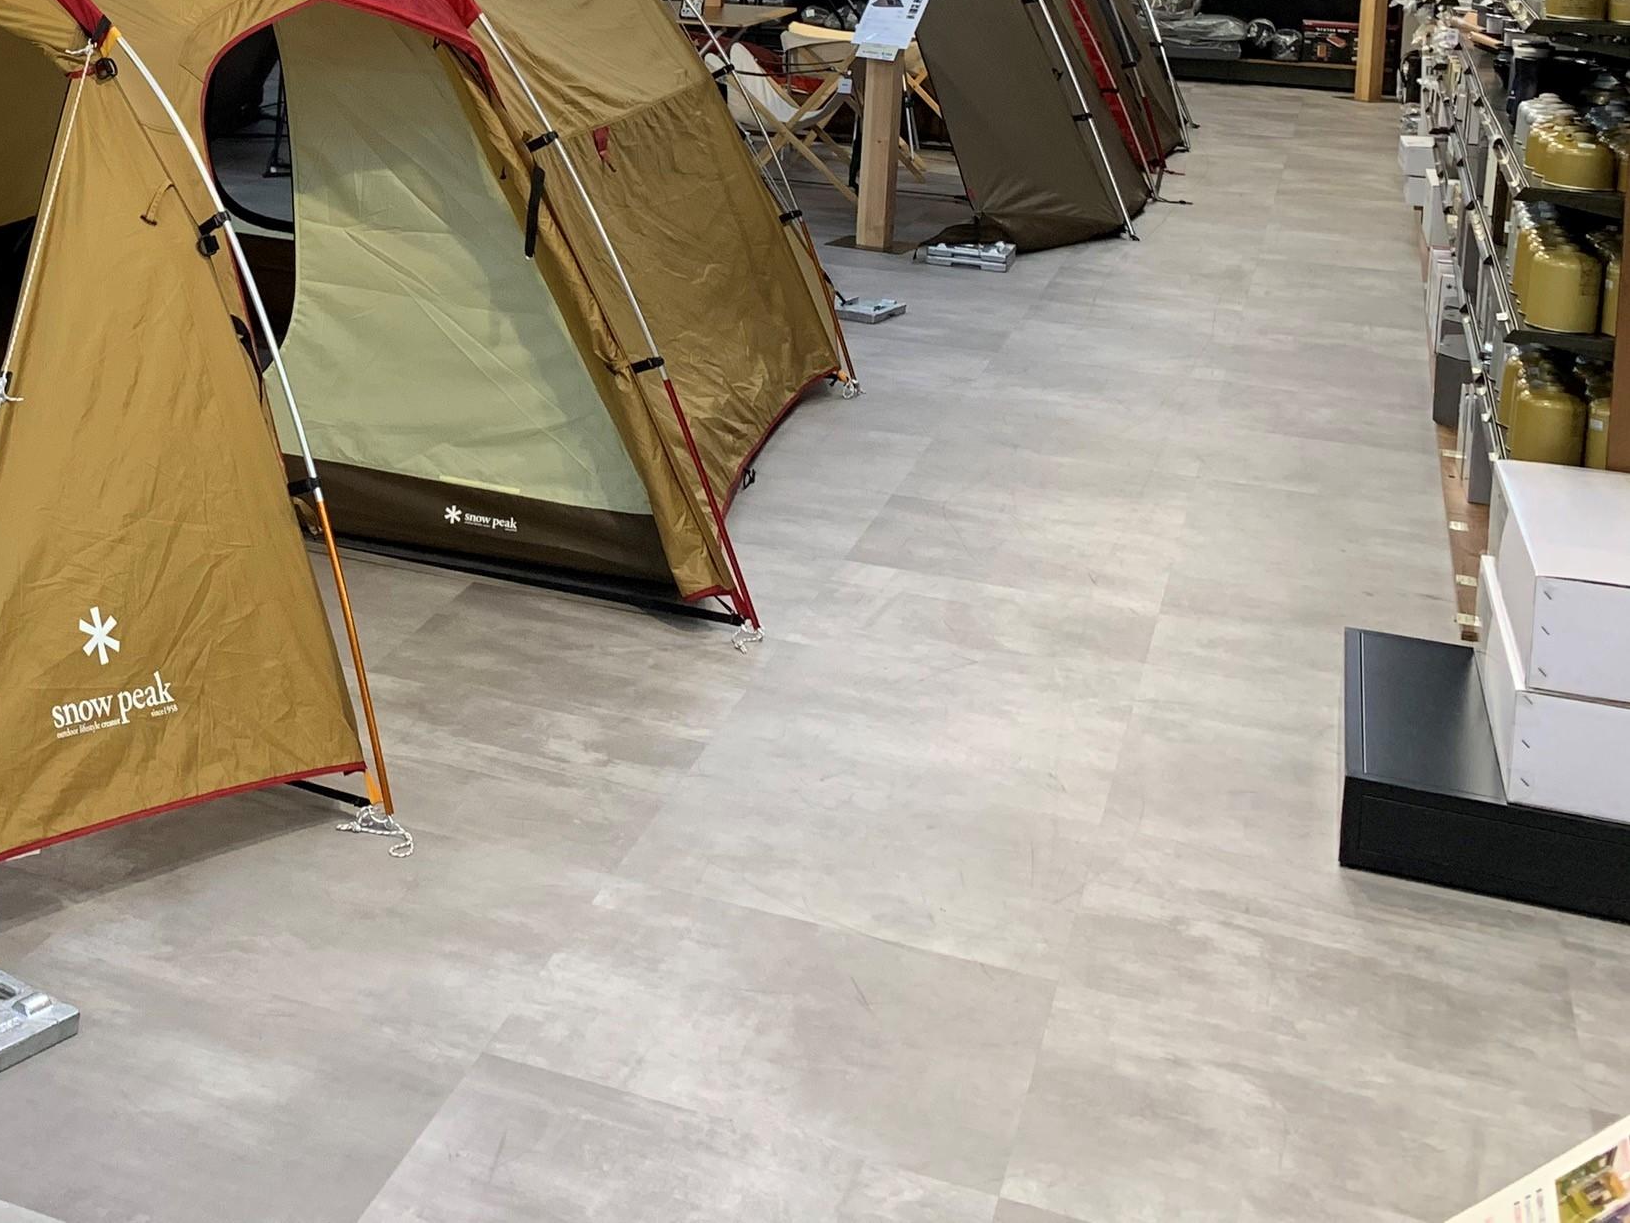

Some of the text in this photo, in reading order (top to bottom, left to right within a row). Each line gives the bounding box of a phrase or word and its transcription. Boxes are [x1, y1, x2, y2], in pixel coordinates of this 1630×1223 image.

[464, 512, 491, 524] snow
[492, 516, 517, 529] peak
[51, 671, 175, 729] snow peak
